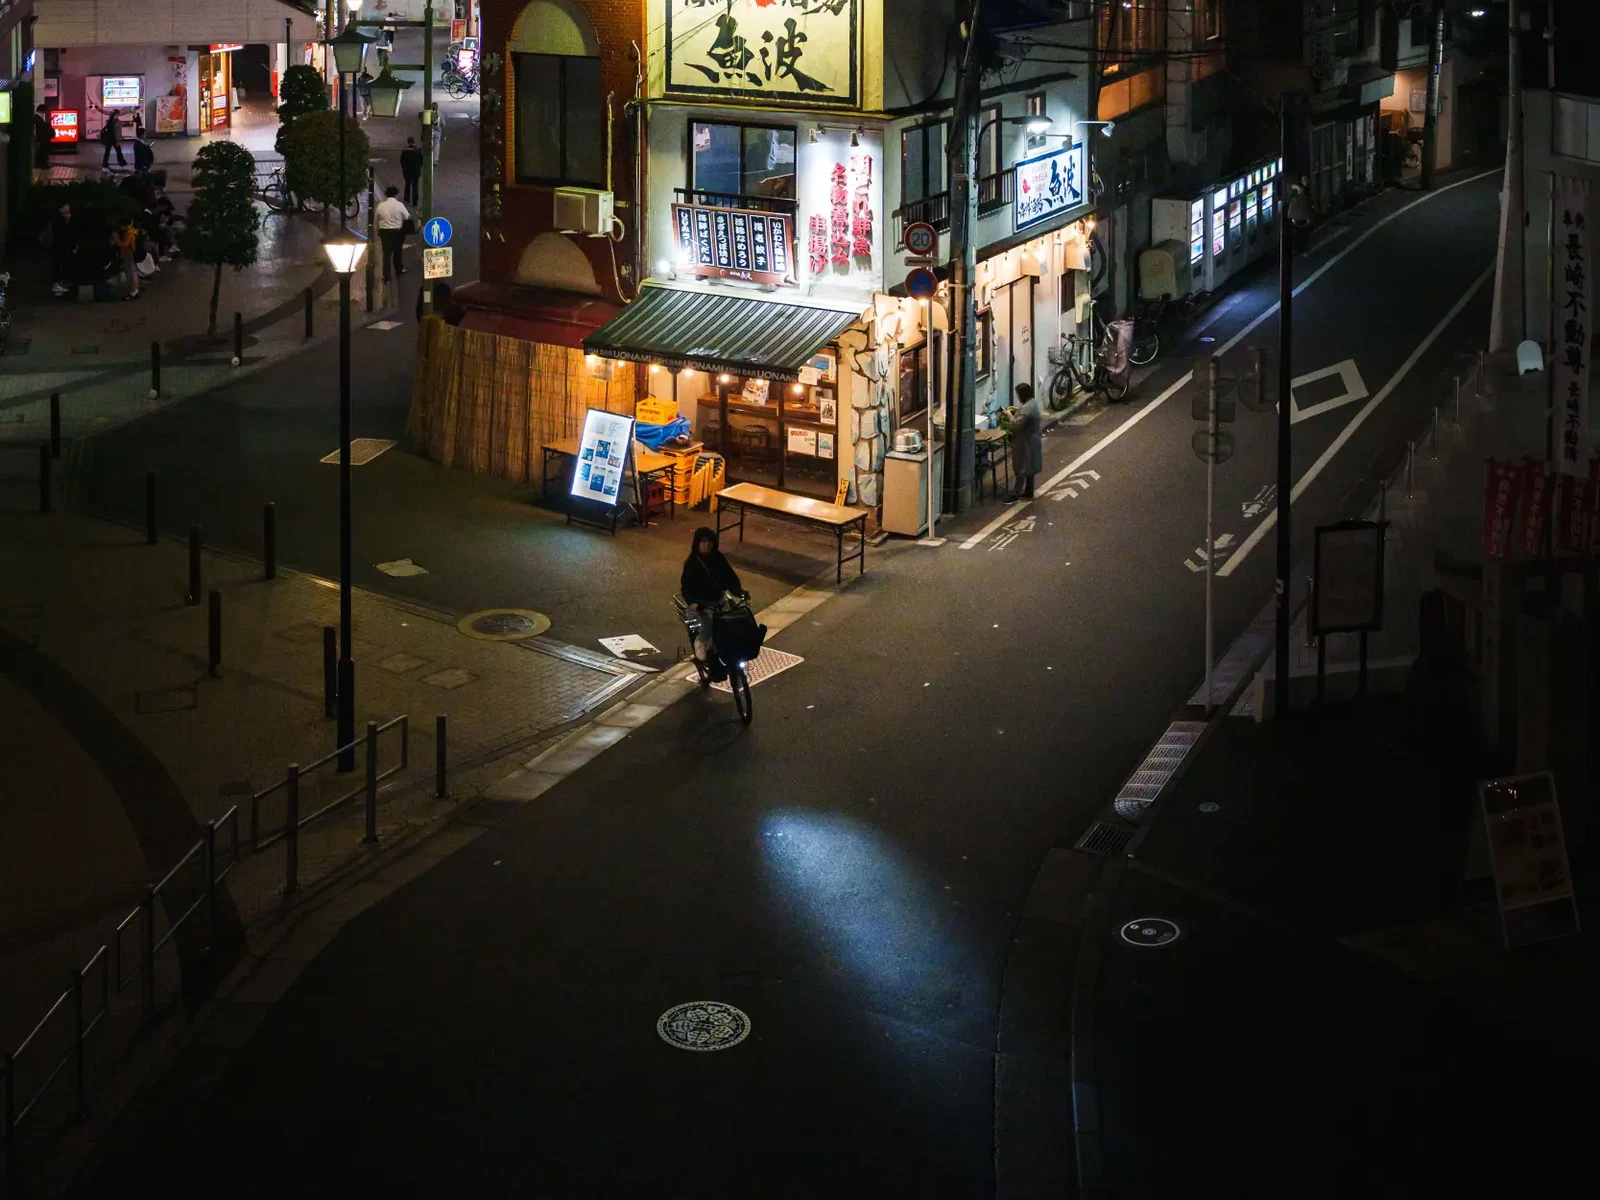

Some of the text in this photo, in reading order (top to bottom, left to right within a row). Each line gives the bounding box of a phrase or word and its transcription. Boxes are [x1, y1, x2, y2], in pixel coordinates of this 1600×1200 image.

[683, 12, 835, 92] 魚波
[1041, 154, 1082, 208] 魚波
[830, 162, 850, 267] 名物煮込み
[912, 232, 930, 247] 20
[807, 213, 828, 275] 串揚げ
[613, 350, 652, 362] UONAMI
[683, 360, 724, 373] UONAMI
[742, 368, 757, 377] BAR
